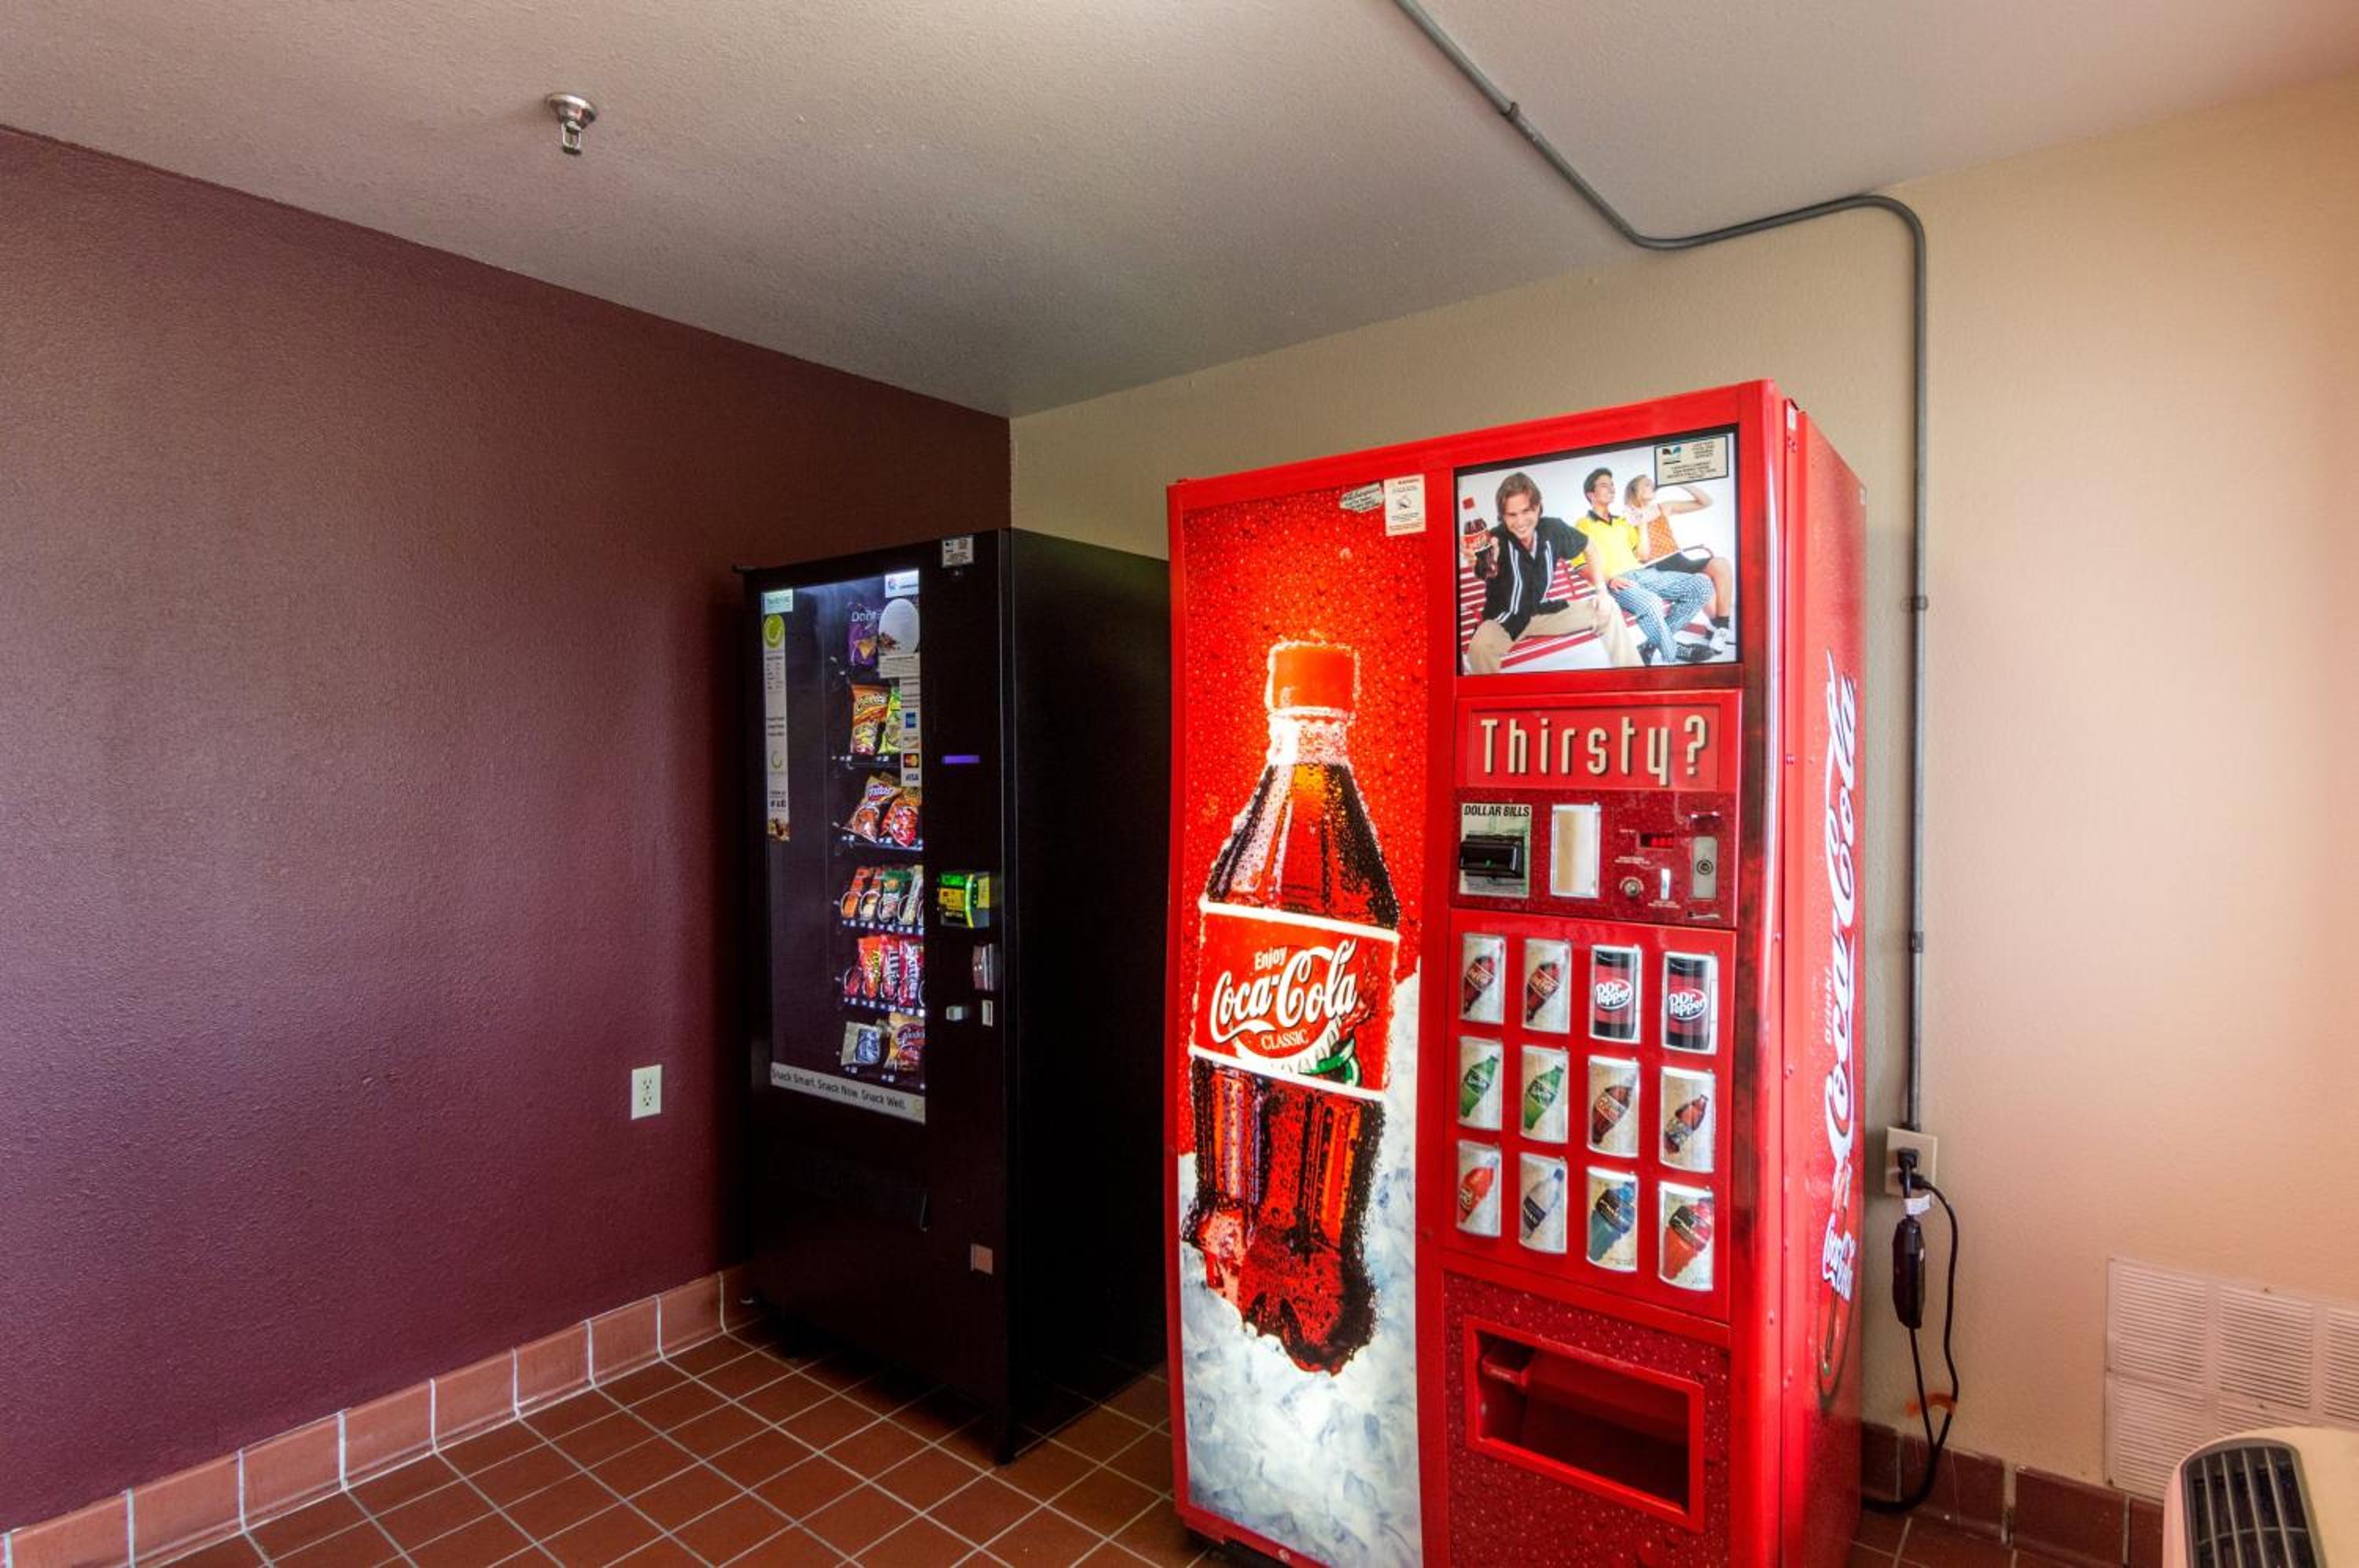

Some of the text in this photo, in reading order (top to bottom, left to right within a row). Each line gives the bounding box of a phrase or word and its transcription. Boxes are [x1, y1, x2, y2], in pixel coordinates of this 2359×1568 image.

[1481, 715, 1706, 786] Thirsty?
[1464, 805, 1529, 817] DOLLAR BILLS
[1824, 647, 1856, 1162] Coca-Cola
[1254, 947, 1287, 970] Enjoy
[1210, 938, 1358, 1043] Coca-Cola
[1596, 983, 1629, 1006] Pepper
[1606, 981, 1622, 994] Dr
[1679, 992, 1696, 1004] Dr
[1669, 994, 1703, 1016] Pepper
[1260, 1029, 1309, 1050] CLASSIC
[818, 1080, 841, 1094] Snack
[861, 1090, 885, 1104] Snack
